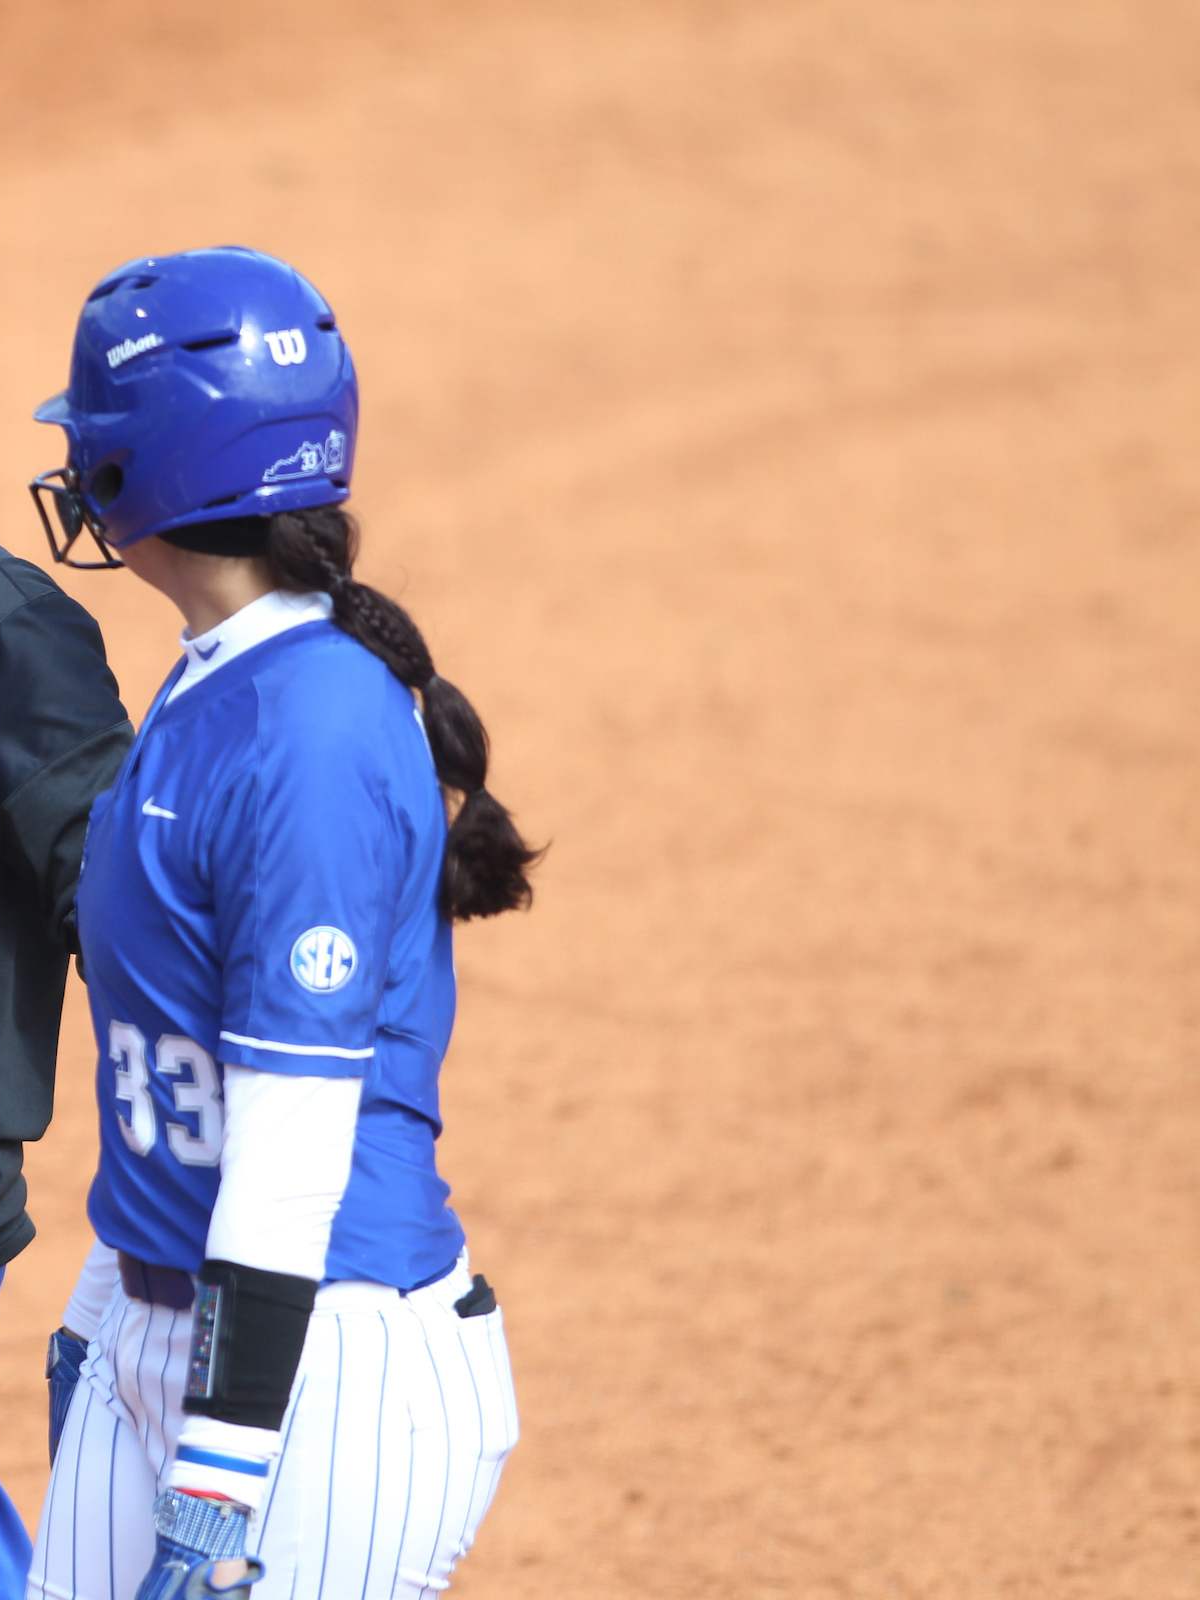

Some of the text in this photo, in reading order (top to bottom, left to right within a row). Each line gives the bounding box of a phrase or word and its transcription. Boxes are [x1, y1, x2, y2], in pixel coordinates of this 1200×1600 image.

[106, 332, 159, 369] Wilson
[294, 929, 353, 990] SEC
[109, 1018, 224, 1167] 33
